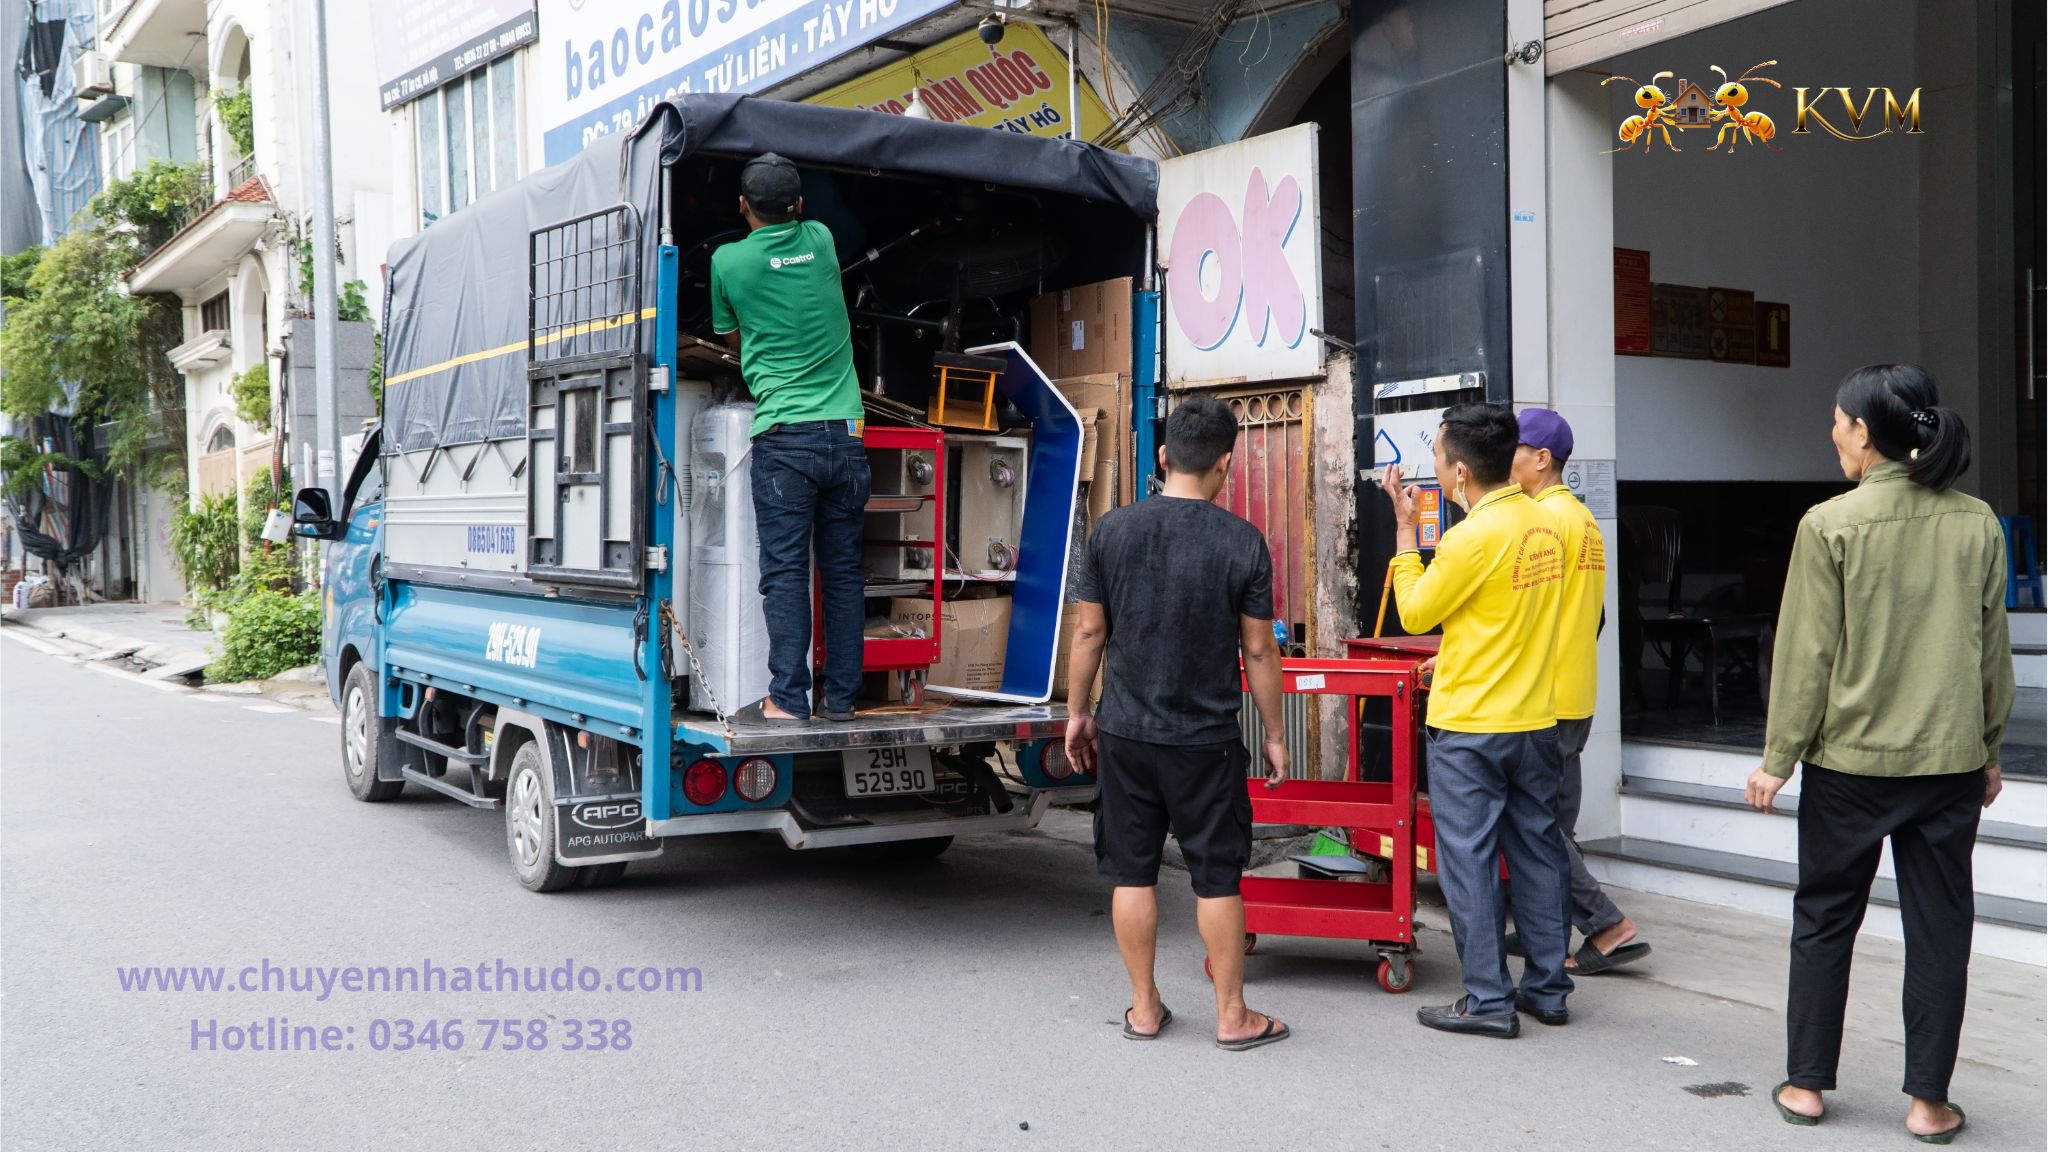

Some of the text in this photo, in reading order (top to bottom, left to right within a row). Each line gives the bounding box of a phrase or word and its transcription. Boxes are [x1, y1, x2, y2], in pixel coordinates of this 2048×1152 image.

[566, 0, 767, 101] baocao
[736, 33, 786, 86] LIÊN
[803, 4, 851, 54] TÂY
[965, 50, 1051, 110] QUỐC
[782, 251, 815, 266] Castrol
[1167, 165, 1307, 352] OK
[467, 525, 516, 555] 0865041668
[485, 621, 542, 670] 29H-529.90
[868, 748, 907, 769] 29H
[855, 769, 926, 793] 529.90
[583, 804, 639, 820] APG
[567, 835, 592, 848] APG
